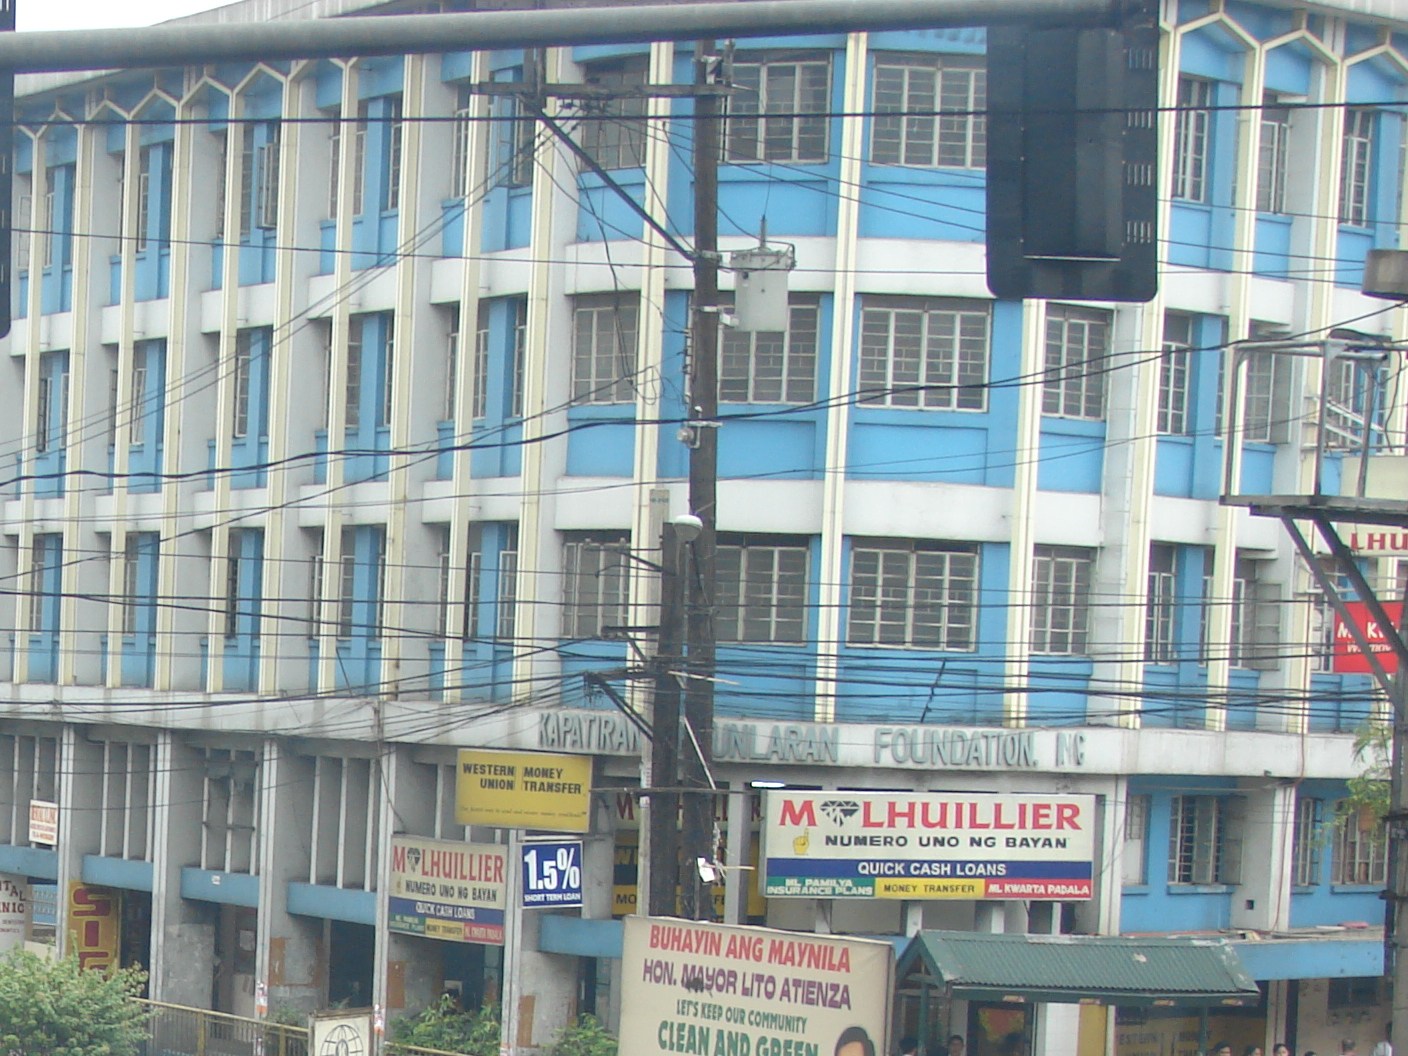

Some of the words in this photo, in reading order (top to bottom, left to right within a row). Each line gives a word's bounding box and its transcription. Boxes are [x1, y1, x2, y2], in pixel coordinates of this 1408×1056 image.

[462, 763, 515, 776] WESTERN
[523, 766, 564, 779] MONEY
[479, 777, 515, 791] UNION
[523, 781, 582, 795] TRANSFER
[861, 801, 1083, 830] LHUILLIER
[825, 835, 908, 847] NUMERO
[918, 836, 959, 848] UNO
[969, 836, 996, 848] NG
[1005, 837, 1067, 849] BAYAN
[420, 849, 504, 884] LHUILLIER
[523, 847, 581, 890] 1.5%
[857, 862, 905, 875] QUICK
[909, 862, 951, 876] CASH
[955, 863, 1007, 876] LOANS
[767, 885, 832, 895] INSURANCE
[834, 887, 874, 896] PLANS
[805, 879, 853, 888] PAMILYA
[883, 883, 918, 892] MONEY
[923, 884, 975, 893] TRANSFER
[1004, 883, 1046, 894] KWARTA
[1047, 884, 1090, 895] PADALA
[405, 880, 437, 897] NUMERO
[439, 885, 454, 900] UNO
[456, 886, 468, 900] NG
[471, 888, 497, 903] BAYAN
[523, 893, 544, 902] SHORT
[545, 893, 562, 902] TERM
[562, 892, 581, 901] LOAN
[415, 902, 435, 915] QUICK
[436, 904, 453, 919] CASH
[648, 924, 722, 957] BUHAYIN
[724, 934, 763, 963] ANG
[766, 939, 851, 973] MAYNILA
[642, 958, 677, 987] HON.
[681, 963, 738, 995] MAYOR
[741, 971, 776, 1001] LITO
[778, 977, 852, 1011] ATIENZA
[676, 998, 699, 1017] LET'S
[700, 1001, 724, 1021] KEEP
[724, 1005, 746, 1025] OUR
[746, 1009, 808, 1034] COMMUNITY
[657, 1019, 711, 1056] CLEAN
